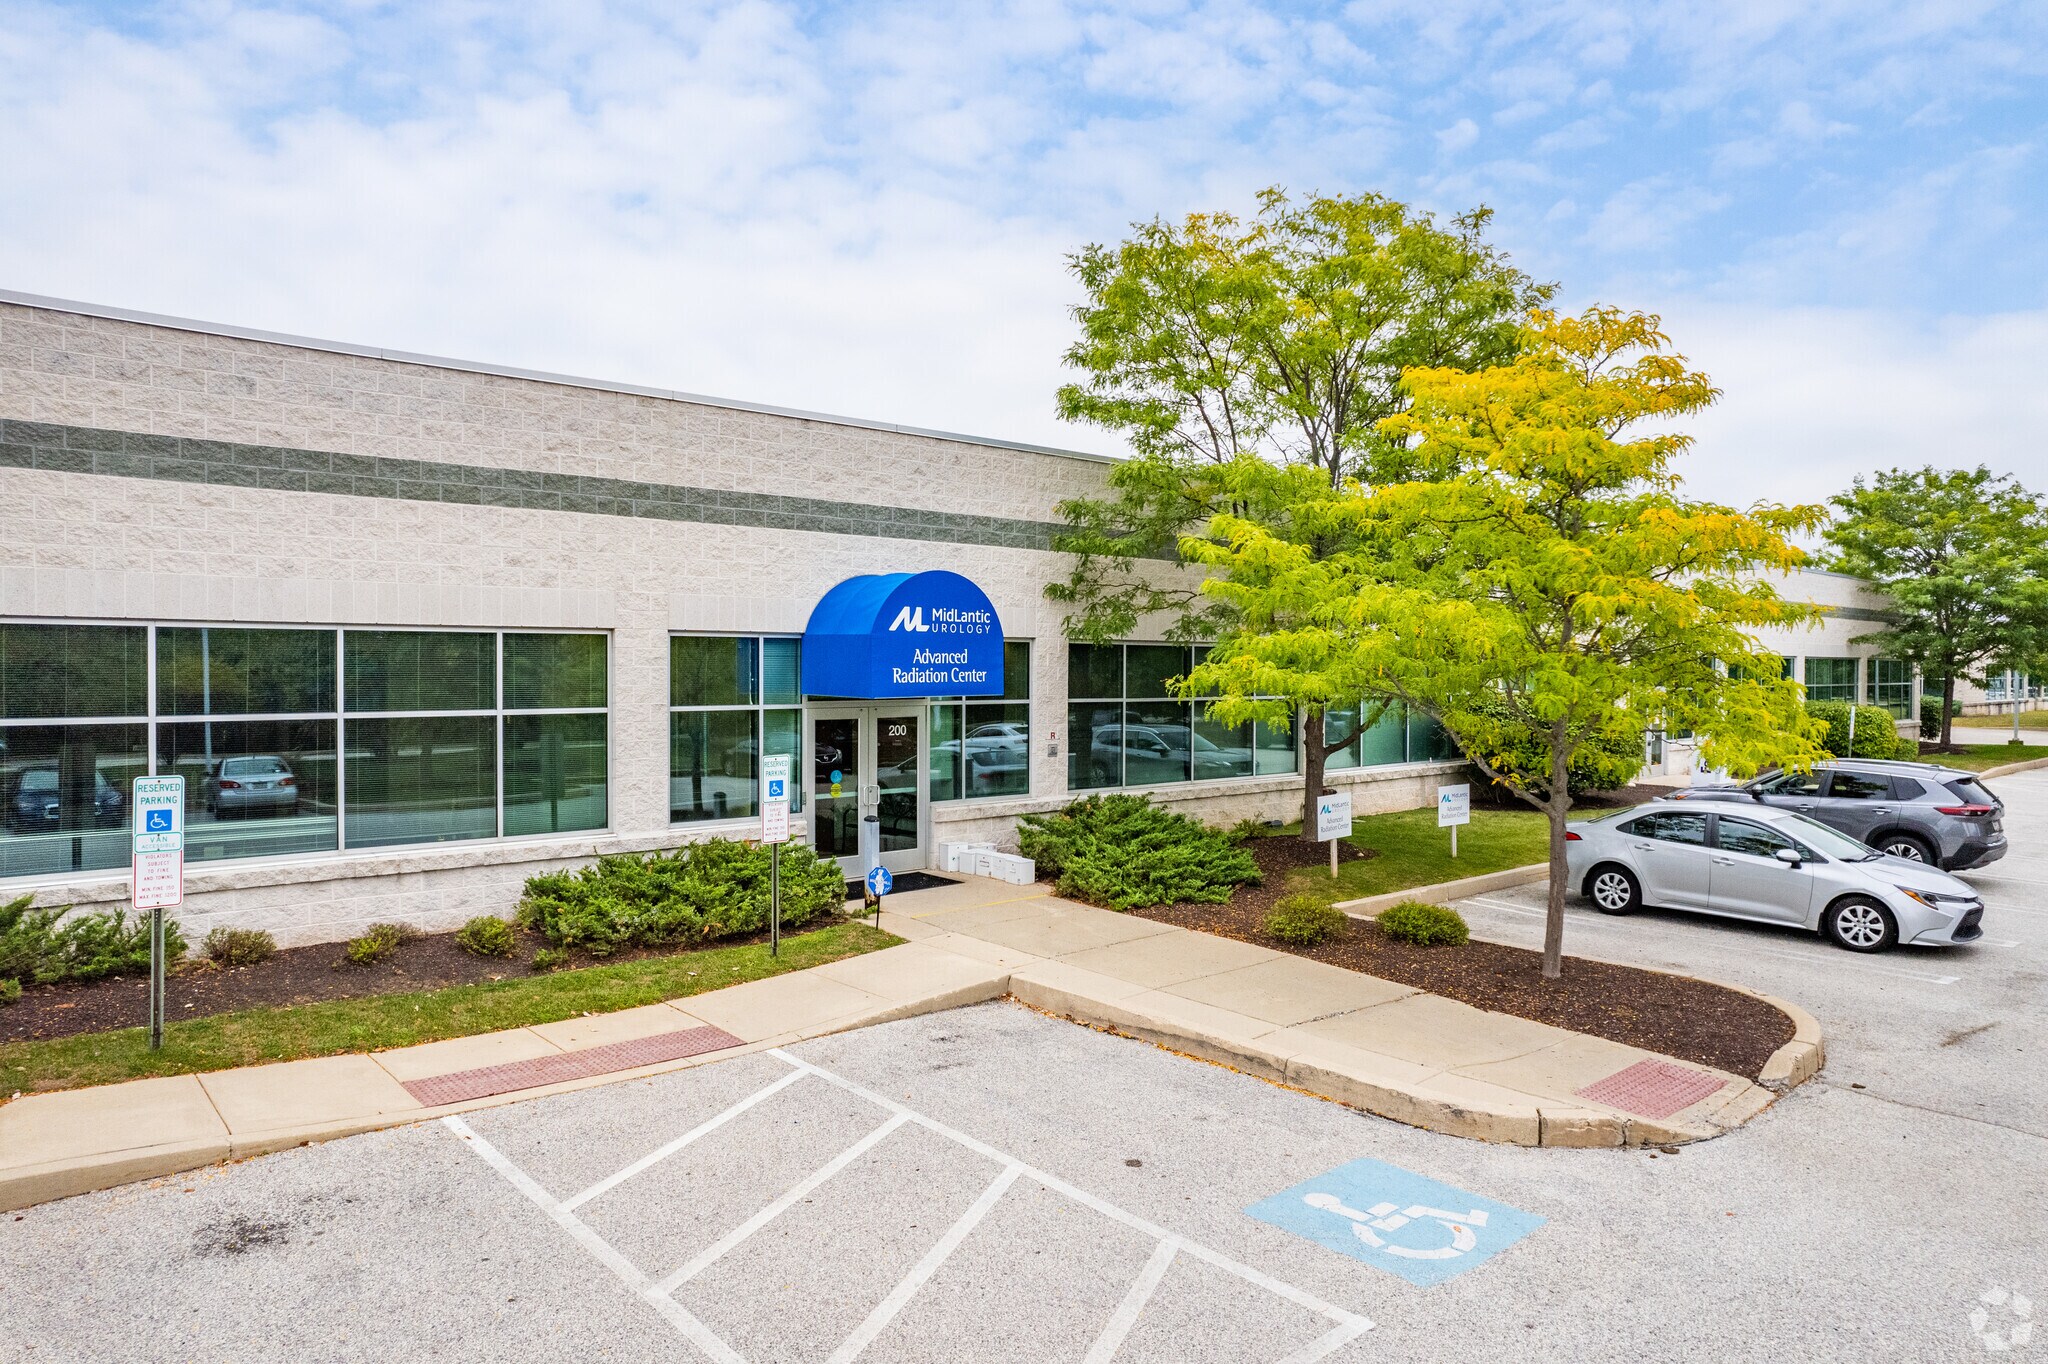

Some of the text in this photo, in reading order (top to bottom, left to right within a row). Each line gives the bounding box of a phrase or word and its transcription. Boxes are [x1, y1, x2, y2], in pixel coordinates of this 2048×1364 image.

[932, 608, 991, 623] MidLantic
[931, 623, 991, 634] UROLOGY
[913, 648, 968, 664] Advanced
[892, 667, 987, 683] Radiation Center
[889, 725, 906, 736] 200
[1050, 732, 1056, 740] R
[765, 769, 787, 777] PARKING
[137, 783, 181, 793] RESERVED
[140, 795, 178, 805] PARKING
